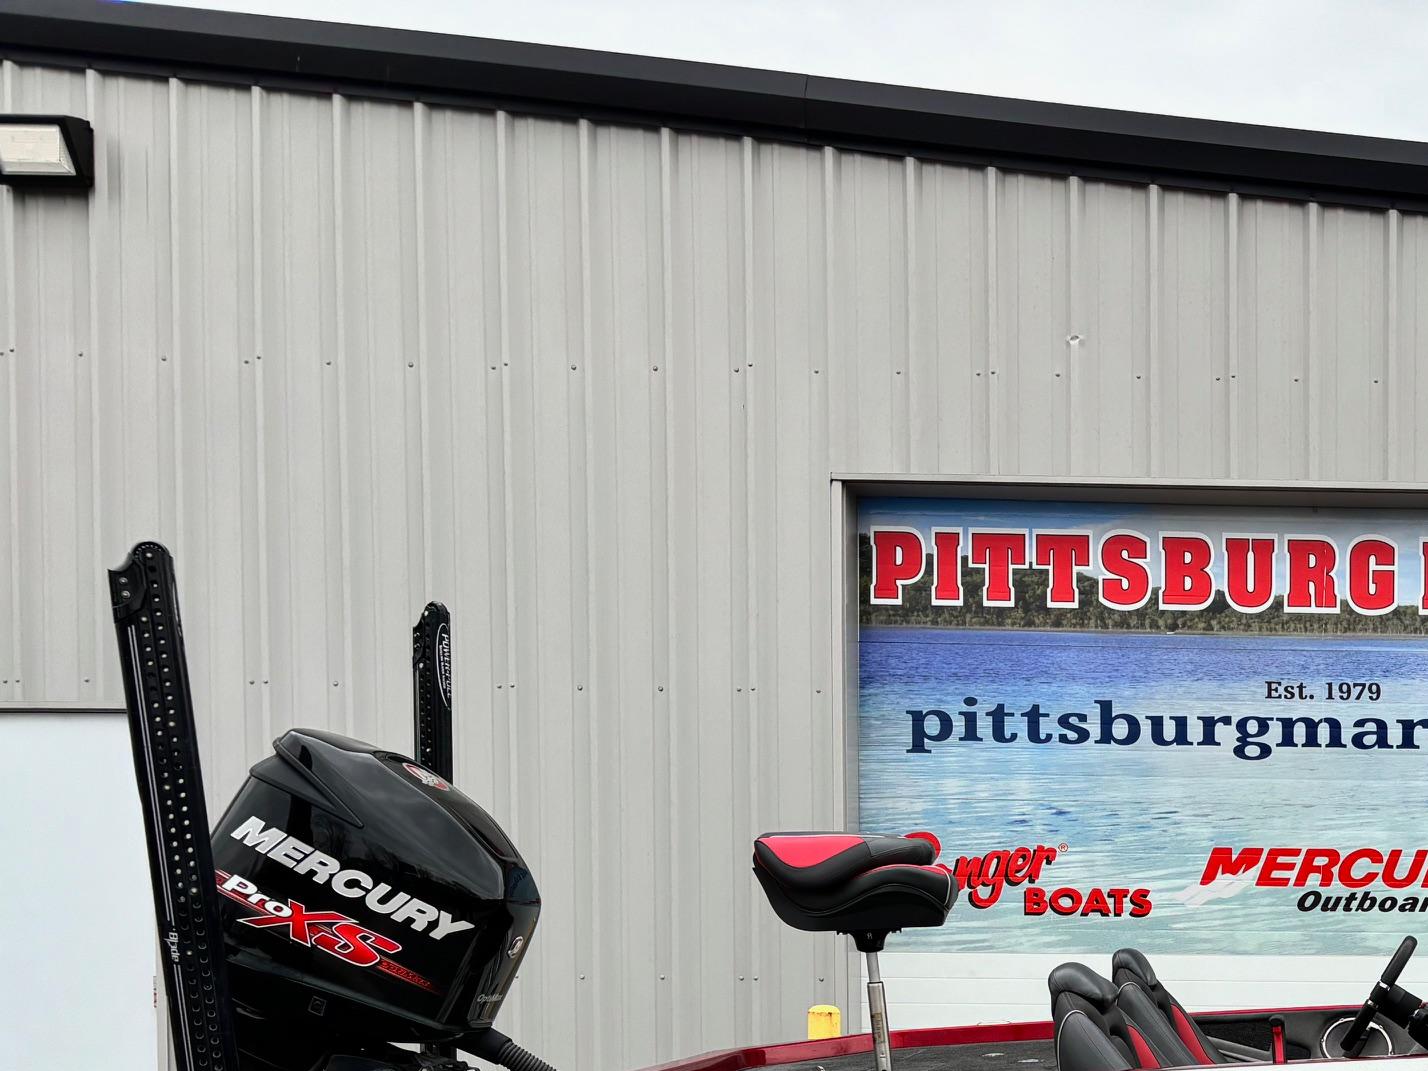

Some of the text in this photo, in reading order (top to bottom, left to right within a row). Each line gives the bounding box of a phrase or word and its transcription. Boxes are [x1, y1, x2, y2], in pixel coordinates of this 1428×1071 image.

[869, 525, 1399, 616] PITTSBURG
[1264, 680, 1382, 701] Est. 1979
[230, 815, 475, 940] MERCURY
[1023, 887, 1153, 917] BOATS
